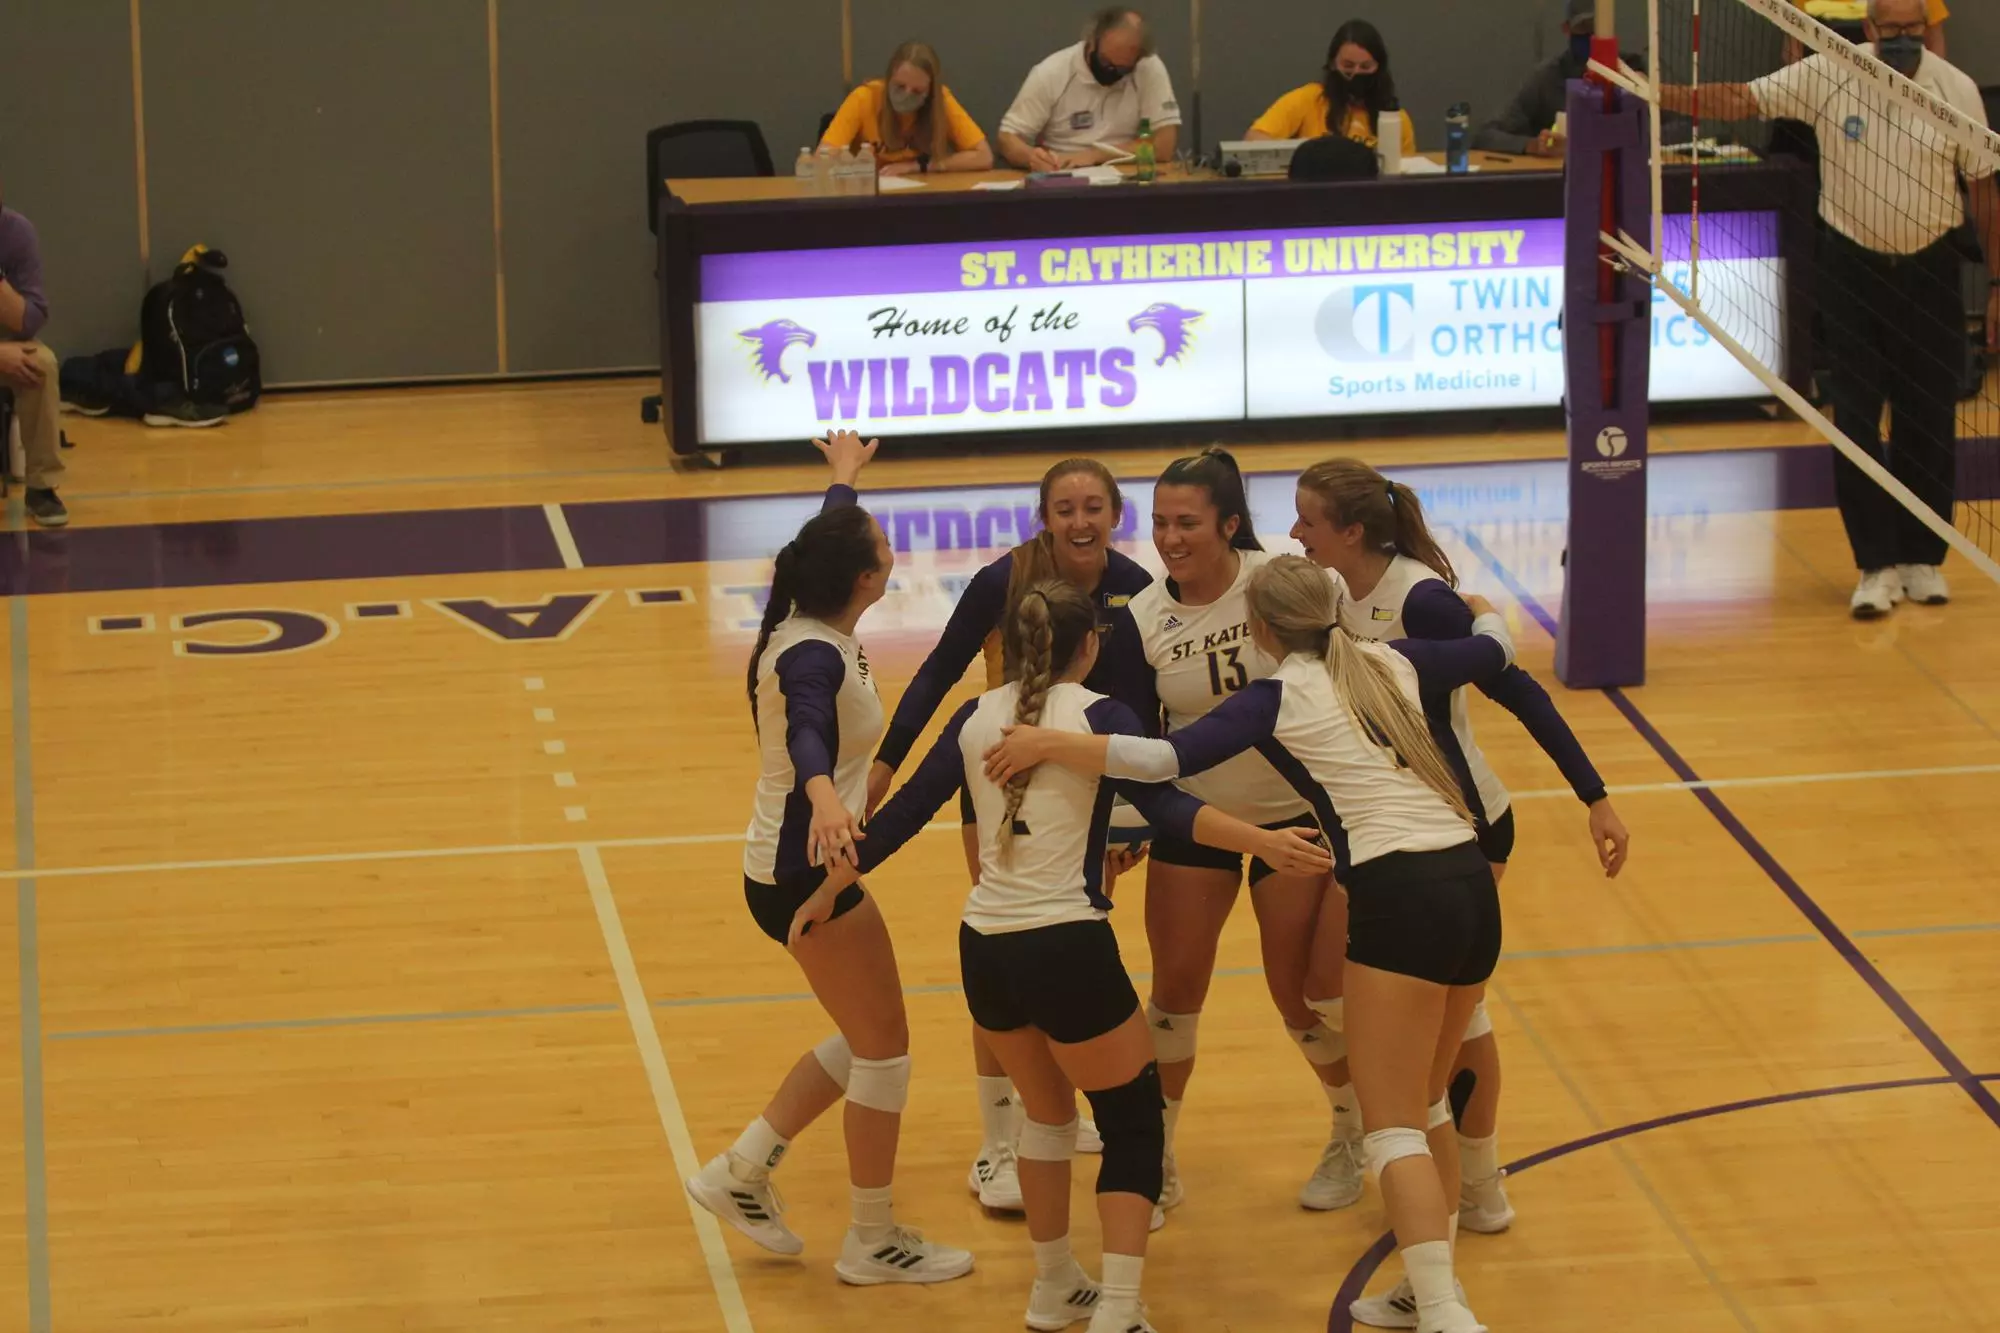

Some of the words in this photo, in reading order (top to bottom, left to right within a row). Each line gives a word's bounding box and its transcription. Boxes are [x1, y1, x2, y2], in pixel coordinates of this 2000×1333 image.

[960, 251, 1028, 287] ST.
[1040, 239, 1273, 283] CATHERINE
[1283, 229, 1526, 273] UNIVERSITY
[1449, 276, 1550, 311] TWIN
[867, 306, 969, 339] Home
[984, 304, 1019, 343] of
[1029, 301, 1080, 332] the
[807, 346, 1138, 421] WILDCATS
[1328, 375, 1406, 398] Sports
[1415, 369, 1521, 392] Medicine
[1171, 640, 1197, 661] ST.
[1206, 645, 1249, 696] 13
